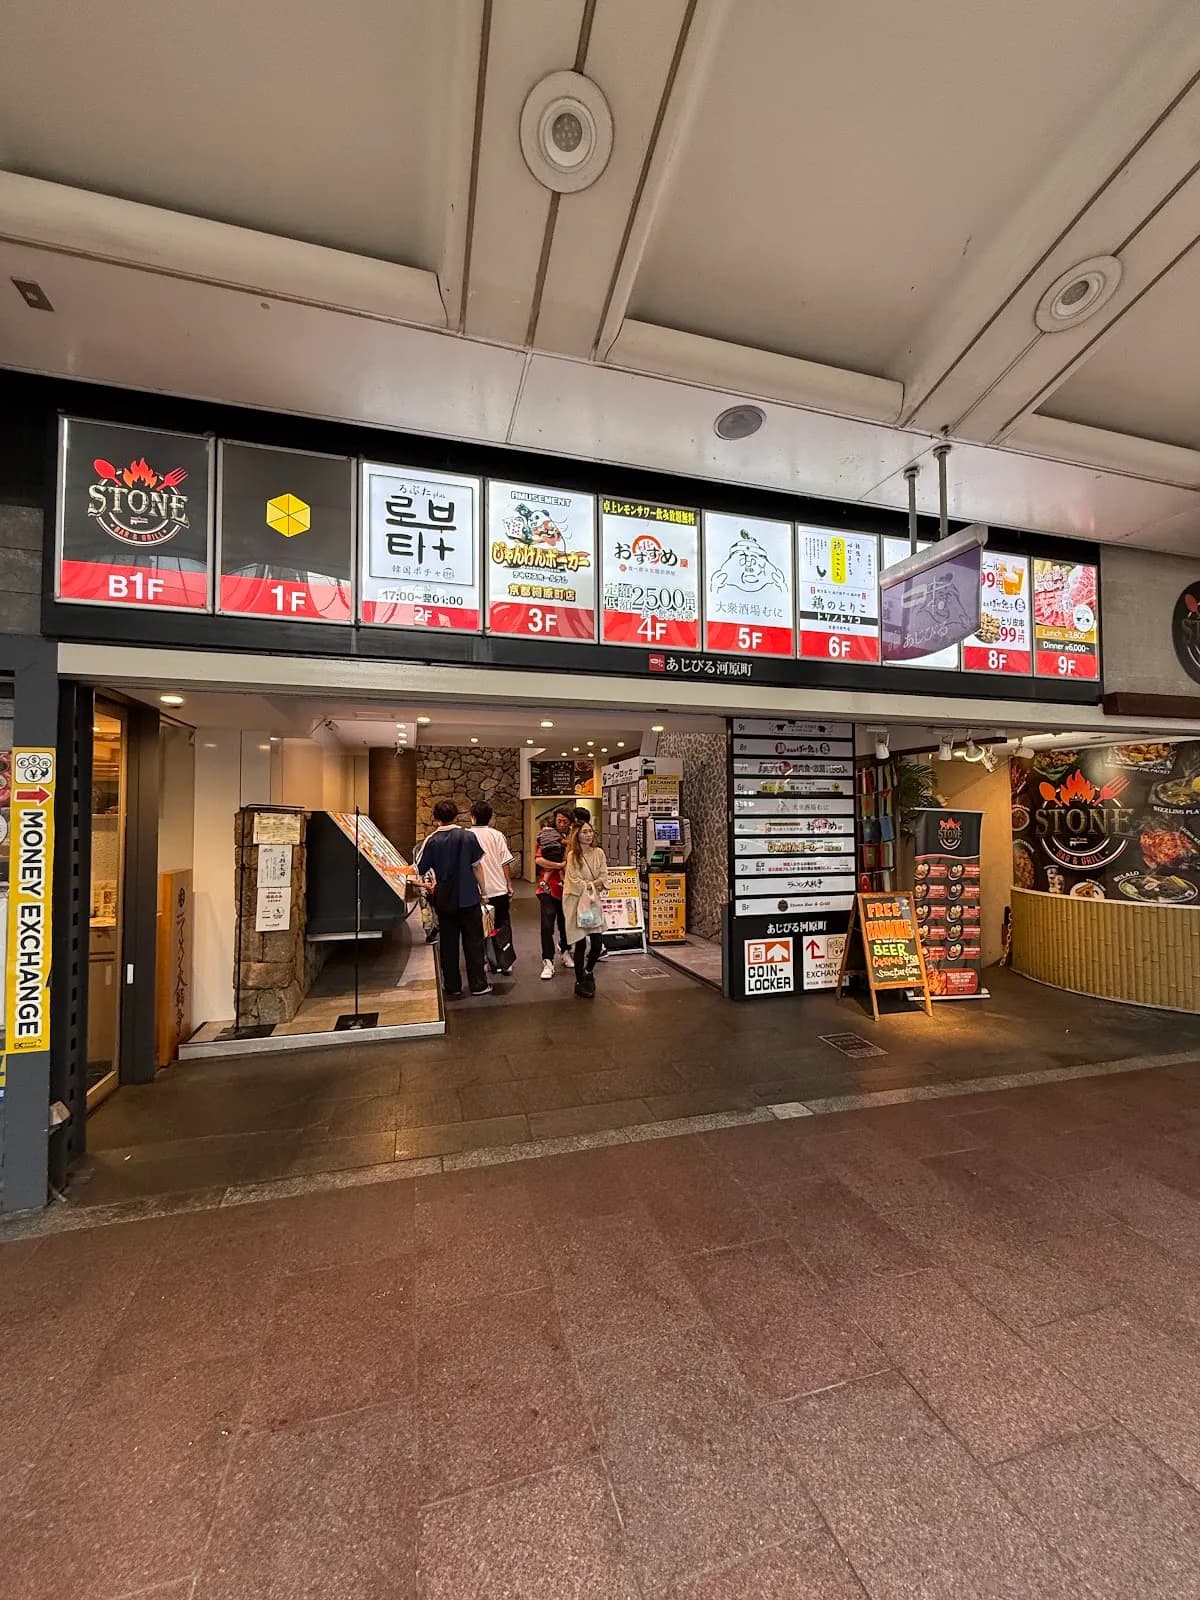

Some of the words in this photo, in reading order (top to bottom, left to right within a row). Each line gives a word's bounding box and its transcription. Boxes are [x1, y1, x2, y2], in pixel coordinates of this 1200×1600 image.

[399, 484, 431, 496] ろぶた
[511, 490, 572, 507] AMUSEMENT
[87, 484, 190, 528] STONE
[603, 499, 695, 525] 卓上レモンサワー飲み放題無料
[114, 526, 129, 538] BAR
[141, 532, 163, 541] GRILL
[492, 541, 590, 571] じゃんけんポーカー
[614, 541, 678, 567] おすすめ
[108, 572, 164, 600] B1F
[508, 583, 576, 602] 京都河原町店
[271, 585, 306, 611] 1F
[811, 595, 866, 613] 鶏のとりこ
[414, 606, 433, 622] 2F
[716, 601, 783, 618] 大衆酒場むに
[818, 612, 861, 624] トリノトリコ
[528, 608, 558, 632] 3F
[637, 617, 667, 641] 4F
[1000, 626, 1017, 643] 99
[1043, 629, 1062, 637] Lunch
[738, 628, 763, 649] 5F
[828, 635, 851, 657] 6F
[1043, 641, 1064, 651] Dinner
[666, 657, 753, 677] あじびる河原町
[988, 650, 1007, 669] 8F
[1058, 656, 1076, 674] 9F
[607, 768, 638, 780] コインロッカー
[1153, 805, 1184, 815] SIZZLING
[1035, 808, 1138, 840] STONE
[938, 829, 962, 840] STONE
[22, 811, 44, 897] MONEY
[1056, 850, 1071, 863] BAR
[1081, 853, 1105, 866] GRILL
[742, 884, 750, 892] 1F
[866, 902, 901, 918] FREE
[767, 921, 828, 935] あじびる河原町
[873, 943, 908, 957] BEER
[18, 904, 42, 1036] EXCHANGE
[748, 964, 784, 978] COIN-
[748, 977, 791, 992] LOCKER
